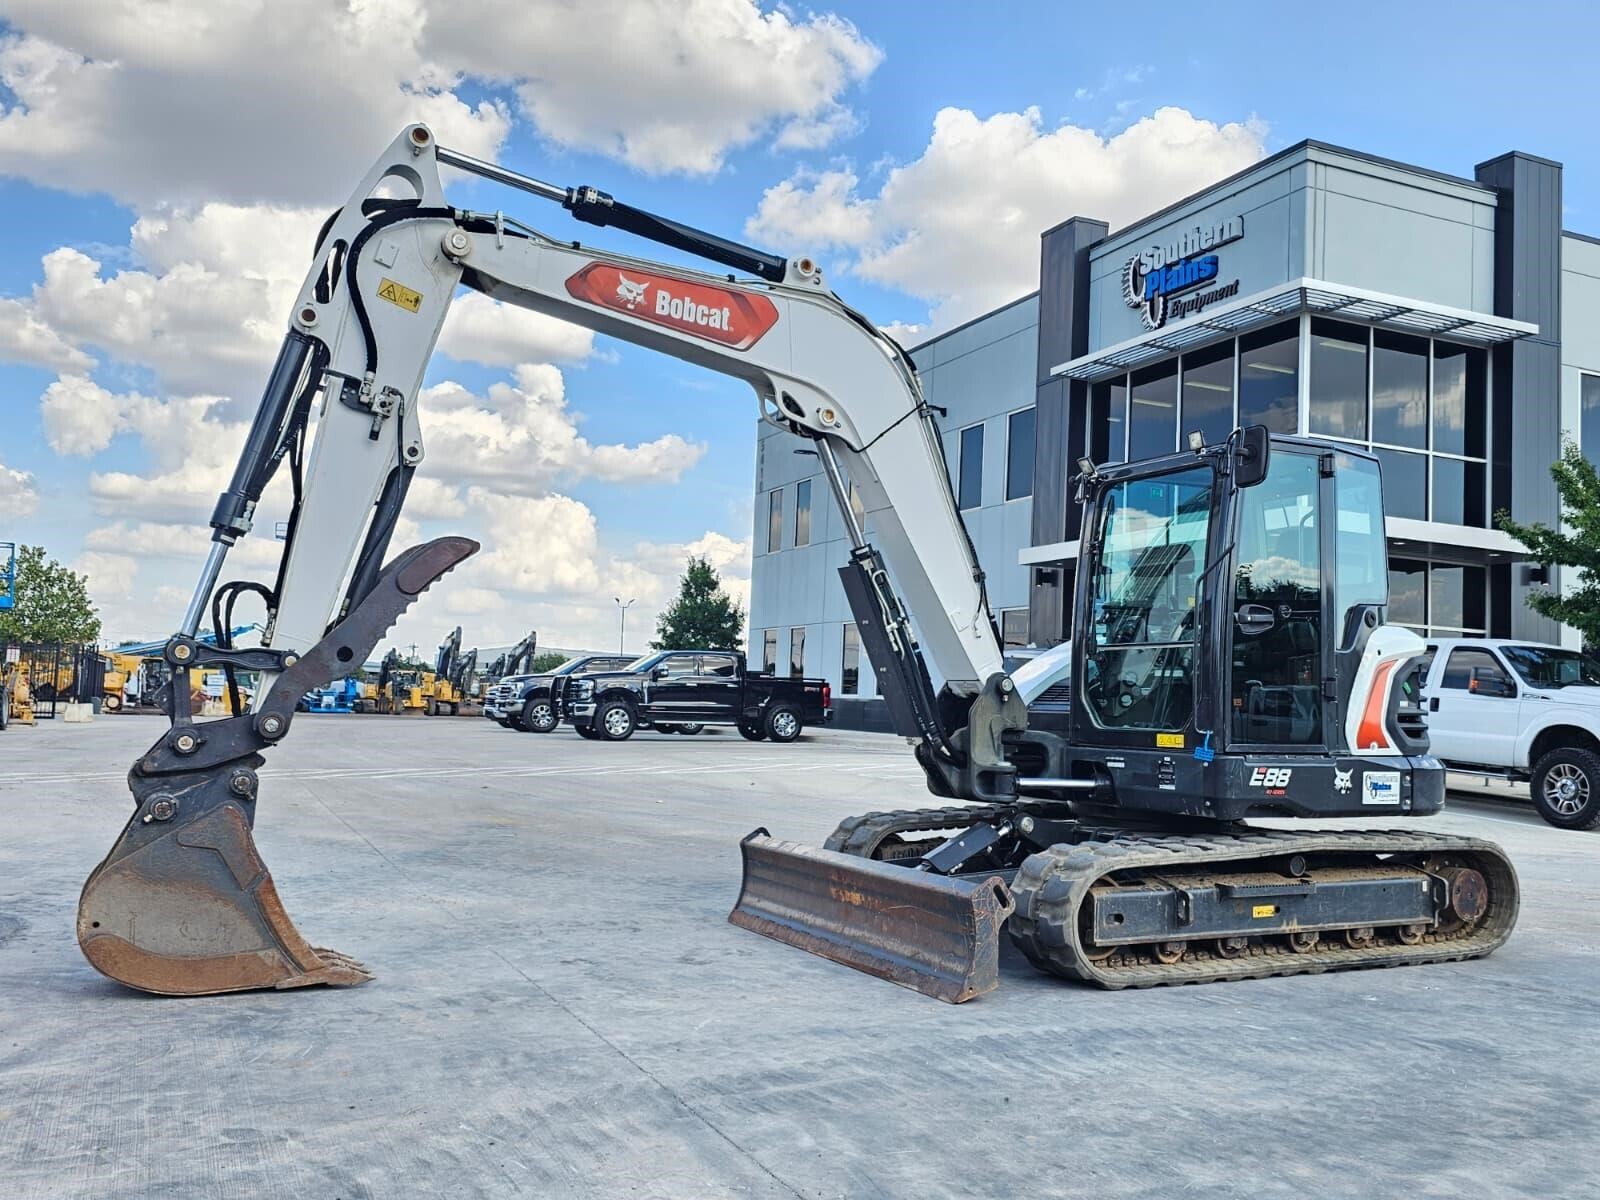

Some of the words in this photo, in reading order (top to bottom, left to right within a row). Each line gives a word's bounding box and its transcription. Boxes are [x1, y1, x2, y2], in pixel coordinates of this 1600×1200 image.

[1139, 215, 1244, 275] Southern
[1145, 255, 1218, 301] Plains
[1168, 279, 1240, 319] Equipment
[656, 289, 730, 331] Bobcat
[1249, 767, 1292, 787] E88
